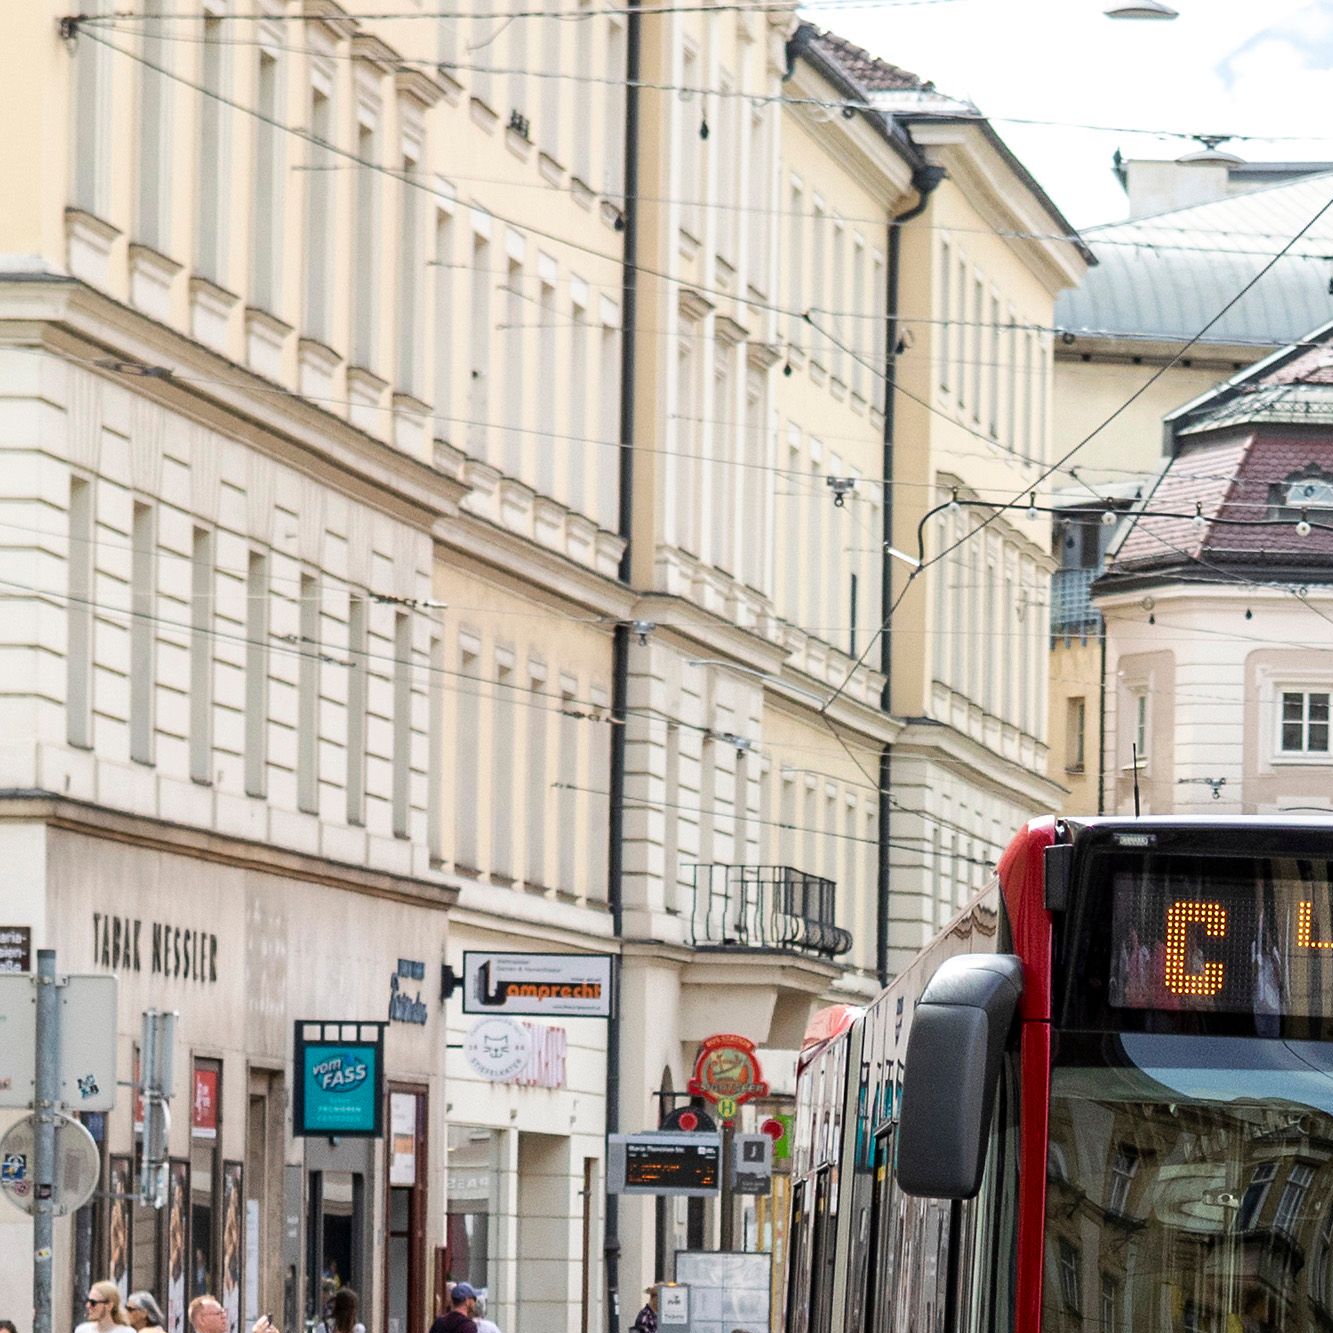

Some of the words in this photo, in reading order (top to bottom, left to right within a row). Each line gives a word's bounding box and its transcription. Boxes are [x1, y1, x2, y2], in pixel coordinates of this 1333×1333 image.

[93, 912, 142, 973] TABAK
[152, 922, 218, 983] NESSLER
[1164, 900, 1227, 996] C
[312, 1058, 342, 1076] vom
[322, 1064, 368, 1090] FASS
